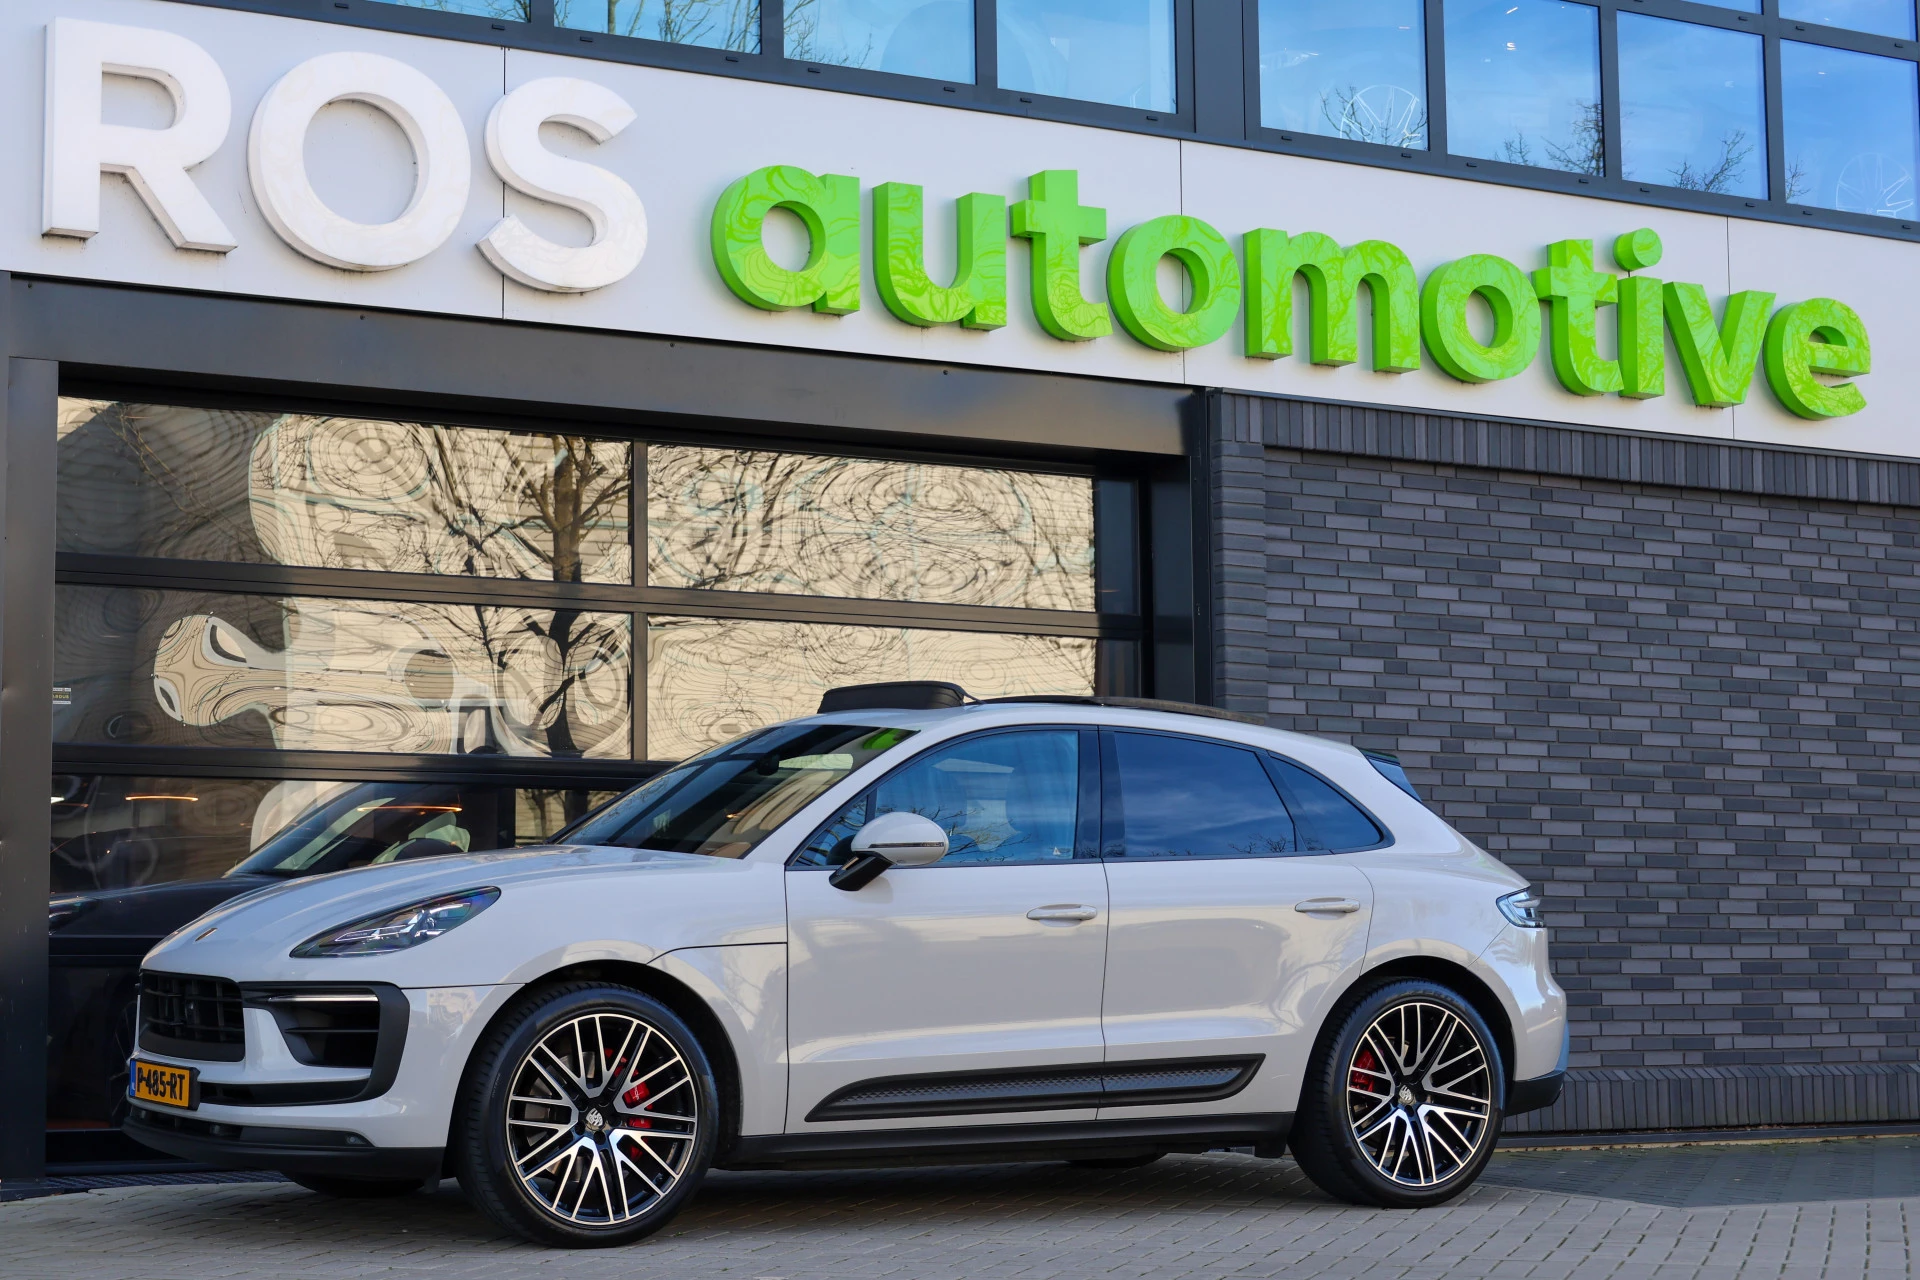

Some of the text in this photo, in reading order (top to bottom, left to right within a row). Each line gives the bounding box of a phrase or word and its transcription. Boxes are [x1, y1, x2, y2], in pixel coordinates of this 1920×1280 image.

[42, 17, 1872, 420] ROS automotive
[137, 1067, 185, 1101] P-485-RT
